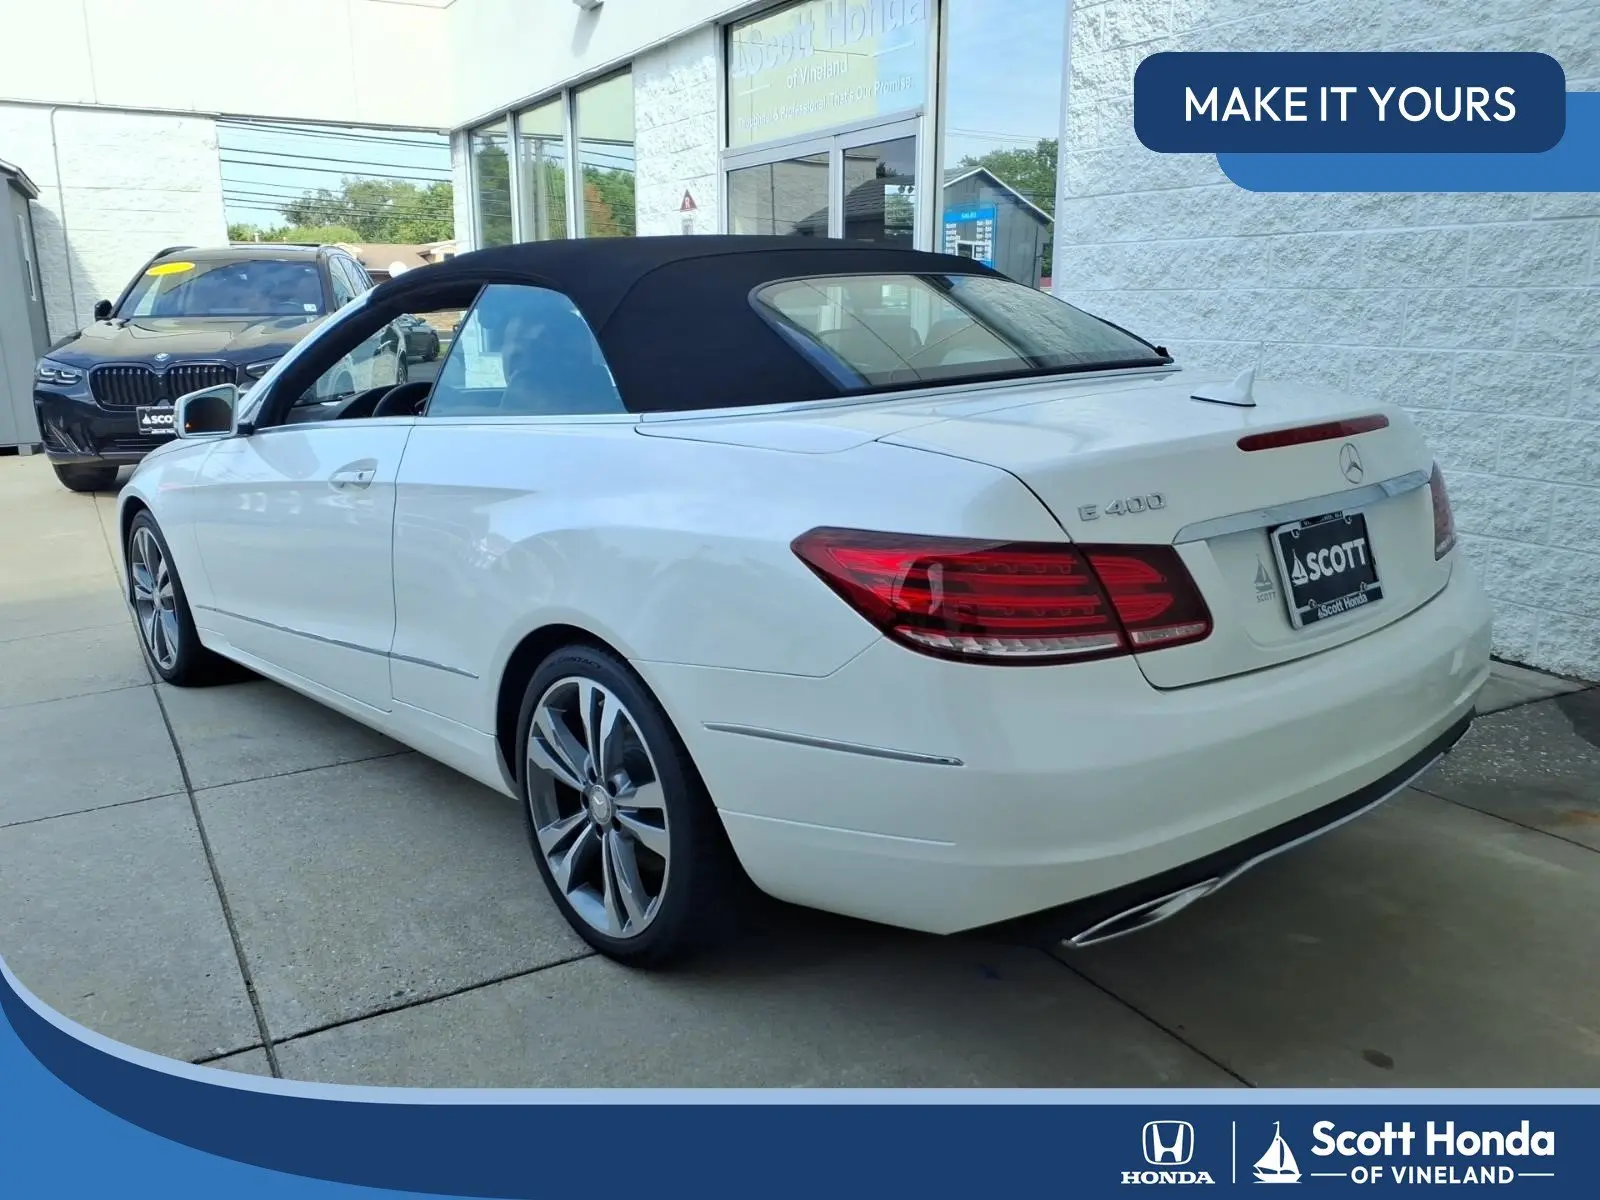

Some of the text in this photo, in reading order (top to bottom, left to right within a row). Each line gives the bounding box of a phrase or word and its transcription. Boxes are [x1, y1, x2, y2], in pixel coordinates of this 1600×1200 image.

[749, 8, 815, 75] Scott
[787, 53, 848, 88] of Vineland
[151, 414, 175, 424] SCO
[1077, 493, 1167, 521] E 400
[1306, 537, 1367, 581] SCOTT
[1320, 592, 1369, 617] Scott Honda
